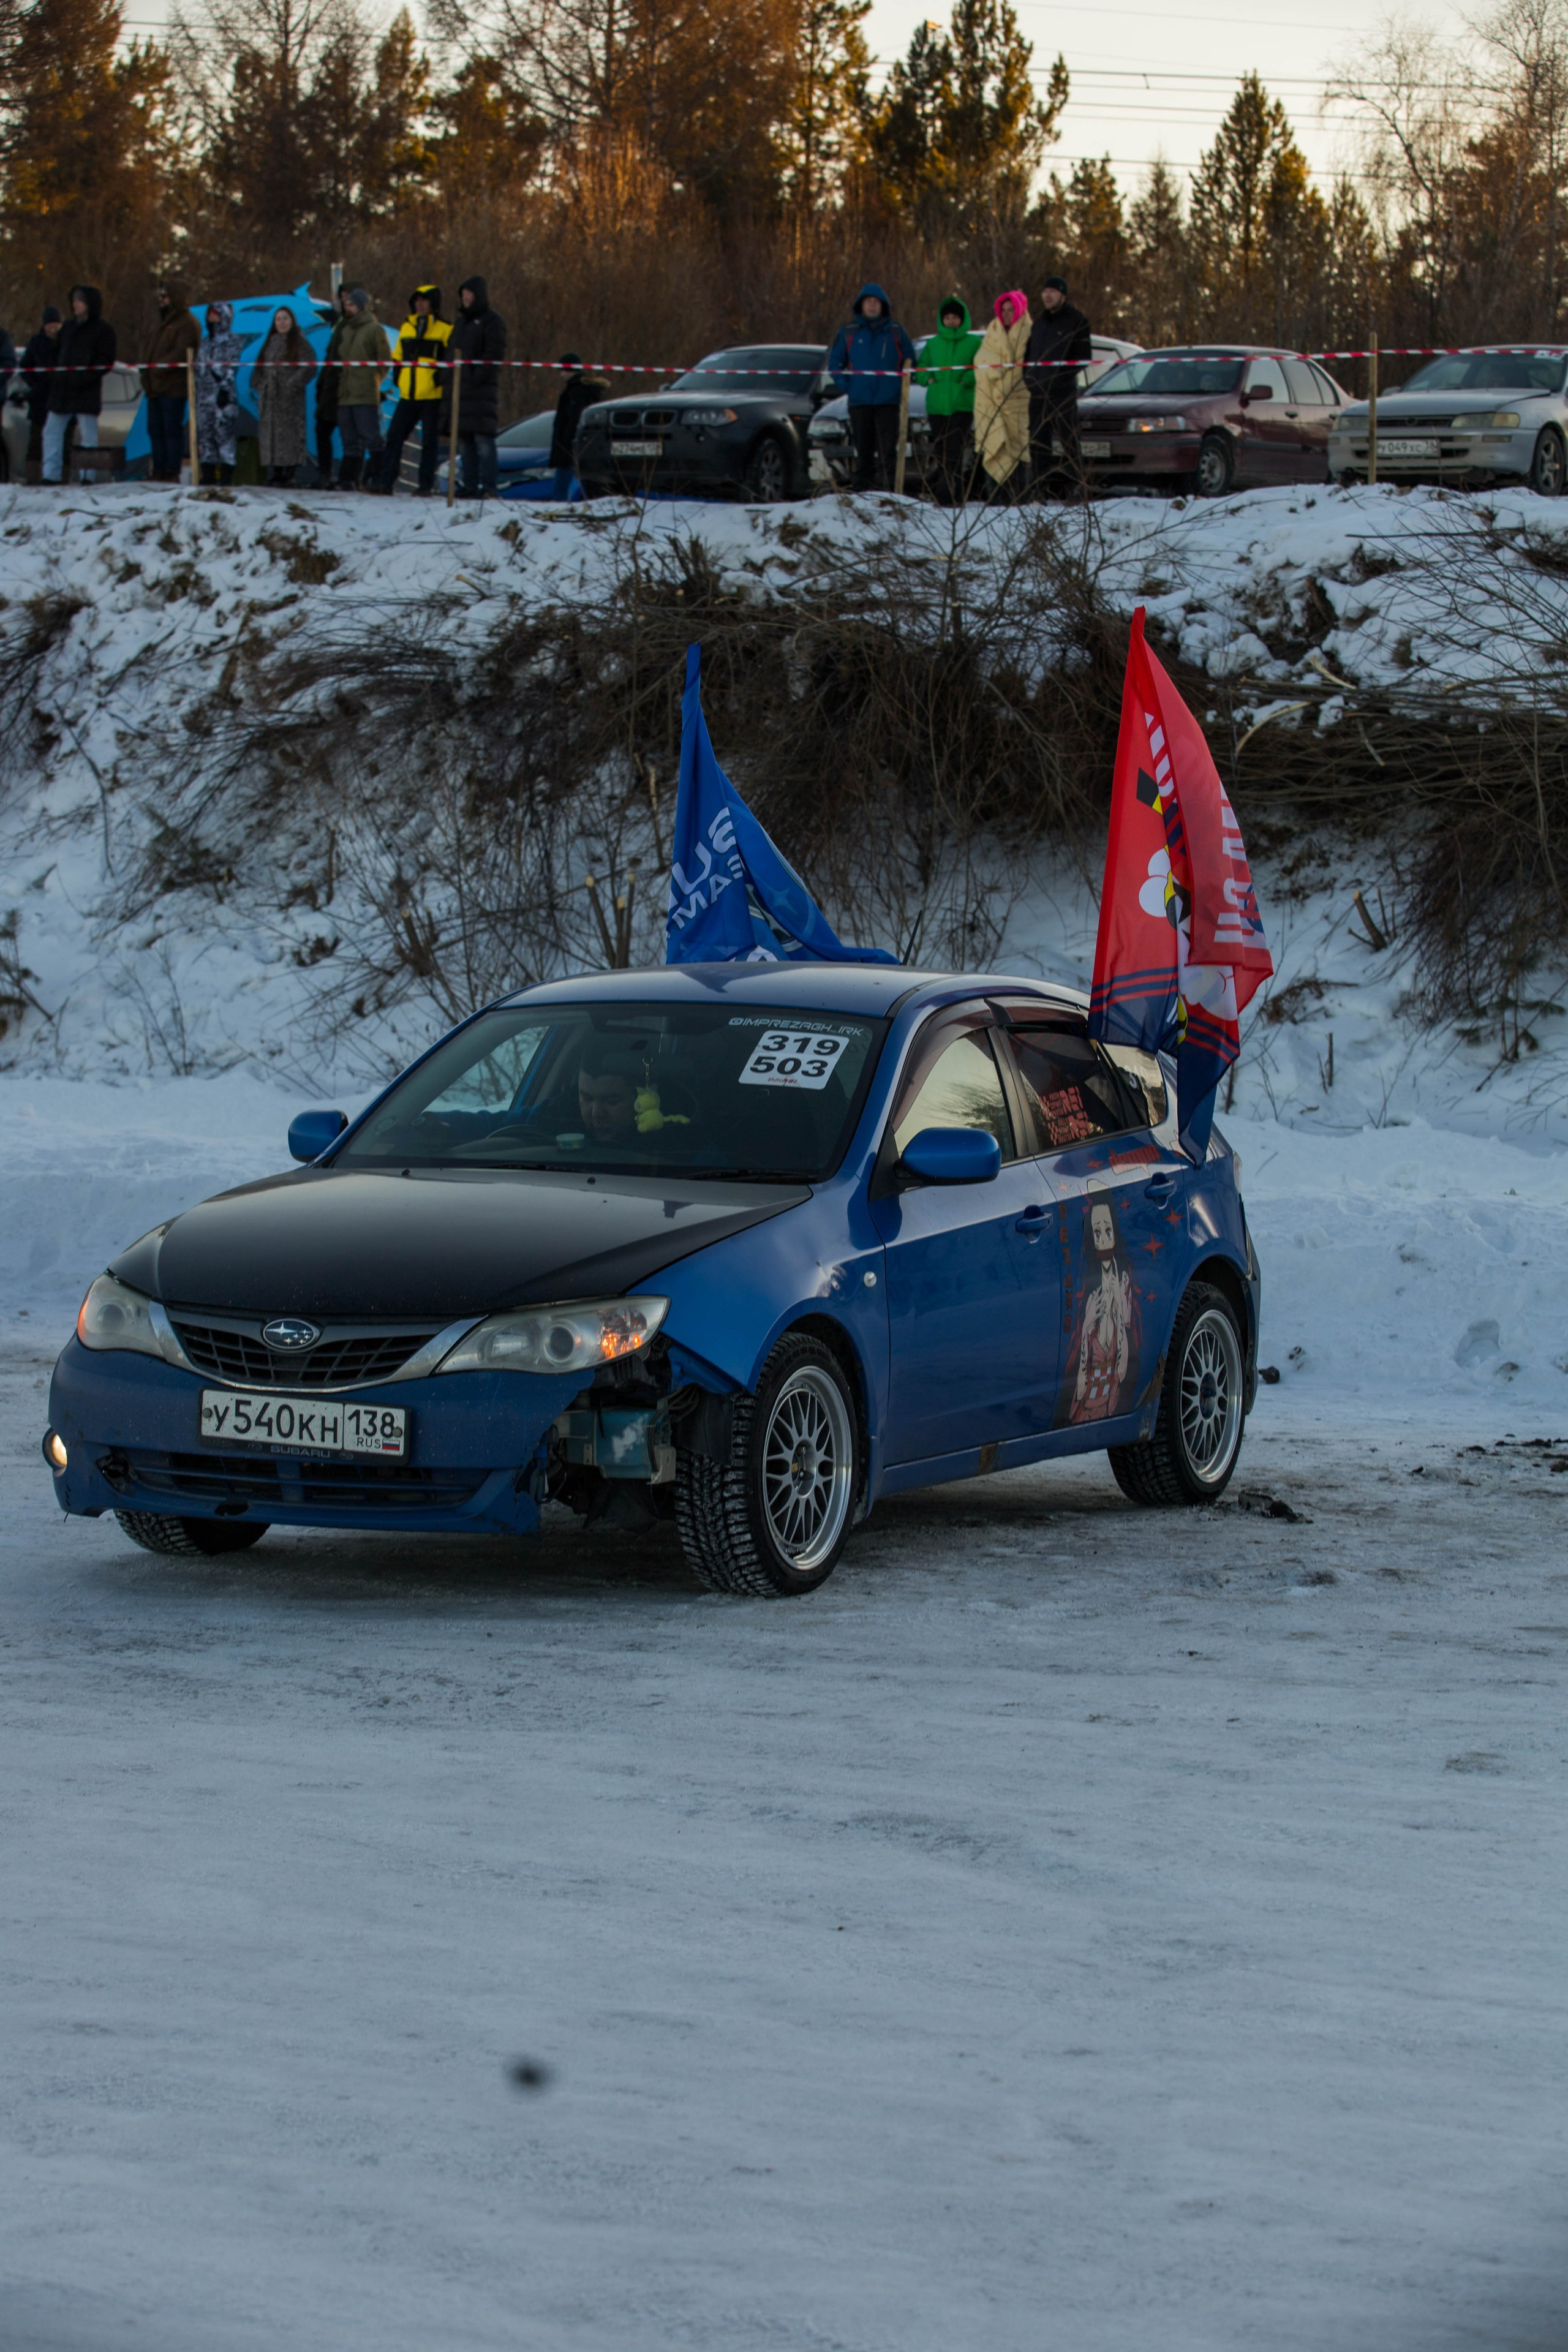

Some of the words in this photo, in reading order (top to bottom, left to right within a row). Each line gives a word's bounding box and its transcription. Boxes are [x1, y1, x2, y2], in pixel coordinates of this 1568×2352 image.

[762, 1035, 840, 1056] 319
[750, 1056, 829, 1077] 503
[348, 1409, 396, 1438] 138
[270, 1445, 331, 1458] SUBARU
[356, 1437, 381, 1449] RUS
